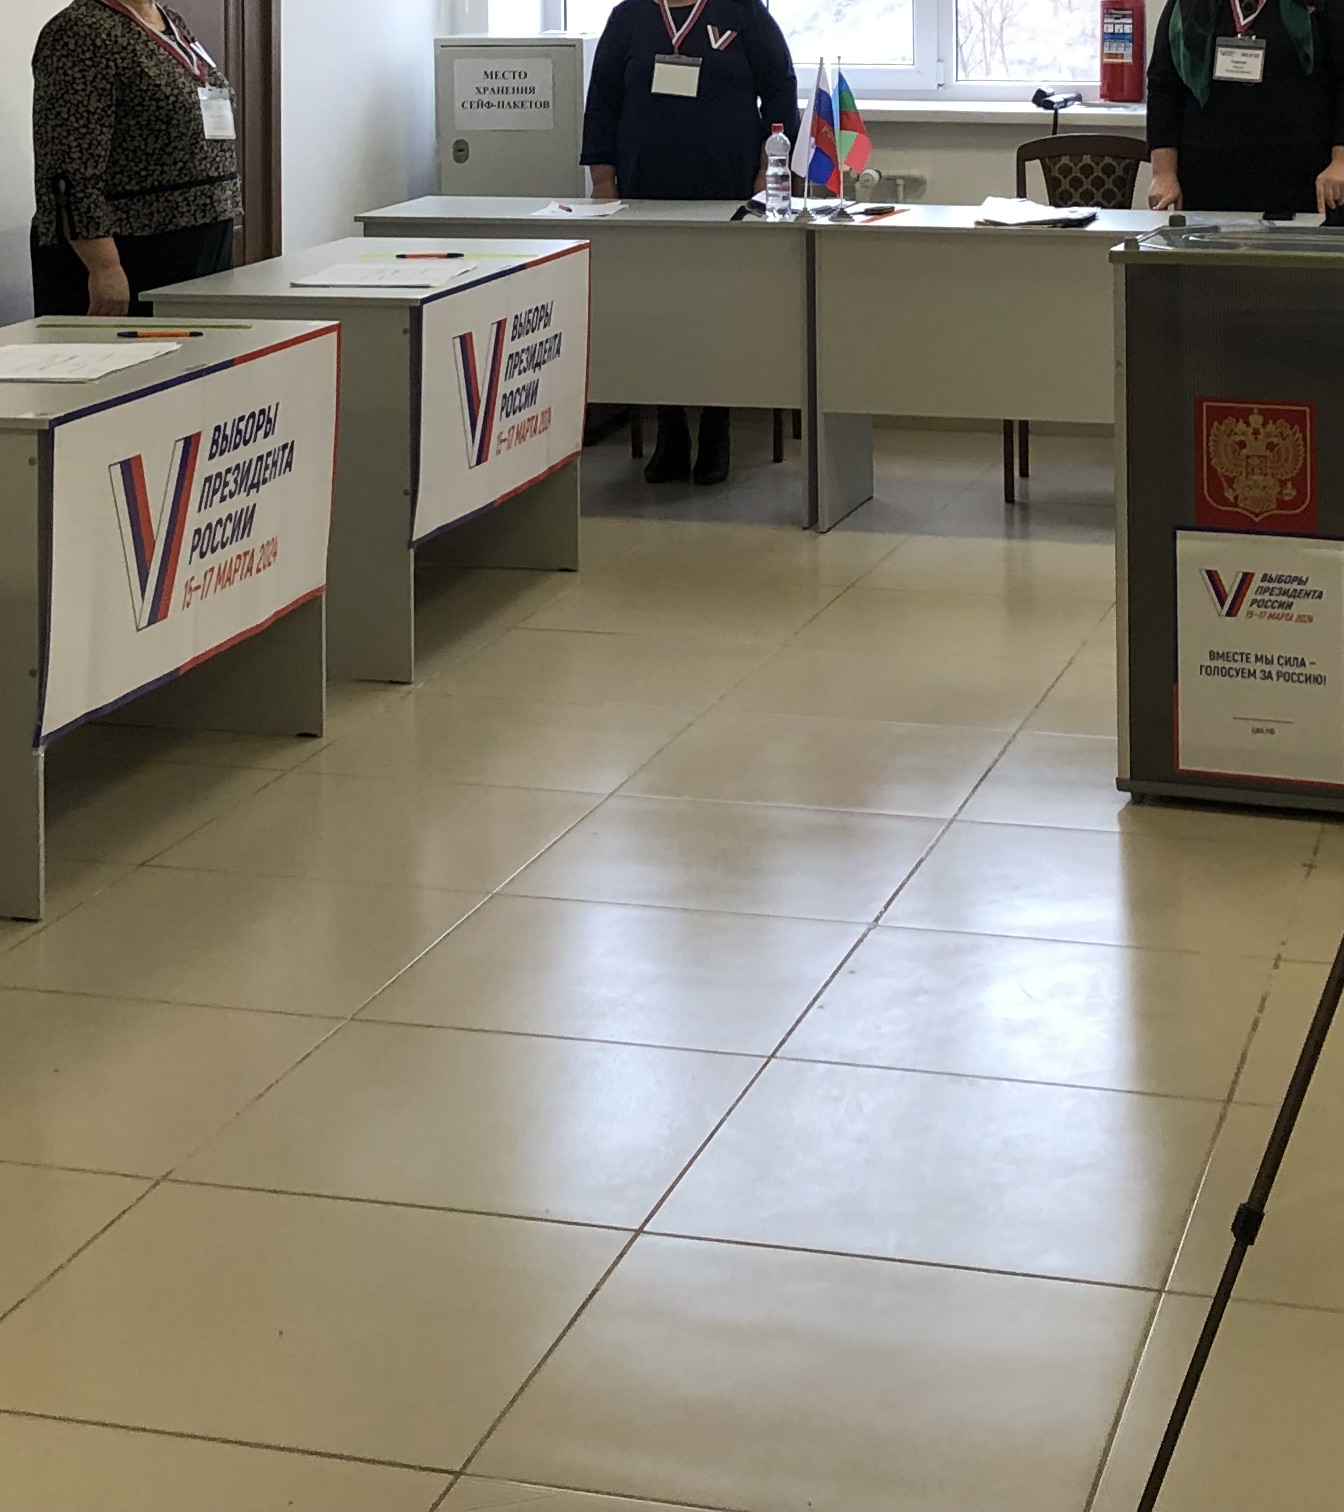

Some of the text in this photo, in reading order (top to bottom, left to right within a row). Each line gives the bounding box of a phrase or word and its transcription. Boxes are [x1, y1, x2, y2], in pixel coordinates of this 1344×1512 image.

[482, 70, 528, 80] МЕСТО
[475, 86, 536, 95] ХРАНЕНИЯ
[461, 99, 550, 109] СЕЙФ-ПАКЕТОВ
[511, 300, 554, 342] ВЫБОРЫ
[504, 331, 563, 381] ПРЕЗИДЕНТА
[499, 377, 540, 421] РОССИИ
[208, 401, 280, 461] ВЫБОРЫ
[197, 439, 296, 513] ПРЕЗИДЕНТА
[188, 502, 257, 565] РОССИИ
[214, 547, 256, 594] МАРТА
[1259, 572, 1309, 586] ВЫБОРЫ
[1254, 585, 1324, 600] ПРЕЗИДЕНТА
[1249, 598, 1294, 610] РОССИИ
[1208, 649, 1252, 664] ВМЕСТЕ
[1254, 652, 1274, 666] МЫ
[1277, 654, 1307, 668] СИЛА
[1199, 664, 1327, 686] ГОЛОСУЕМ ЗА РОССИЮ!
